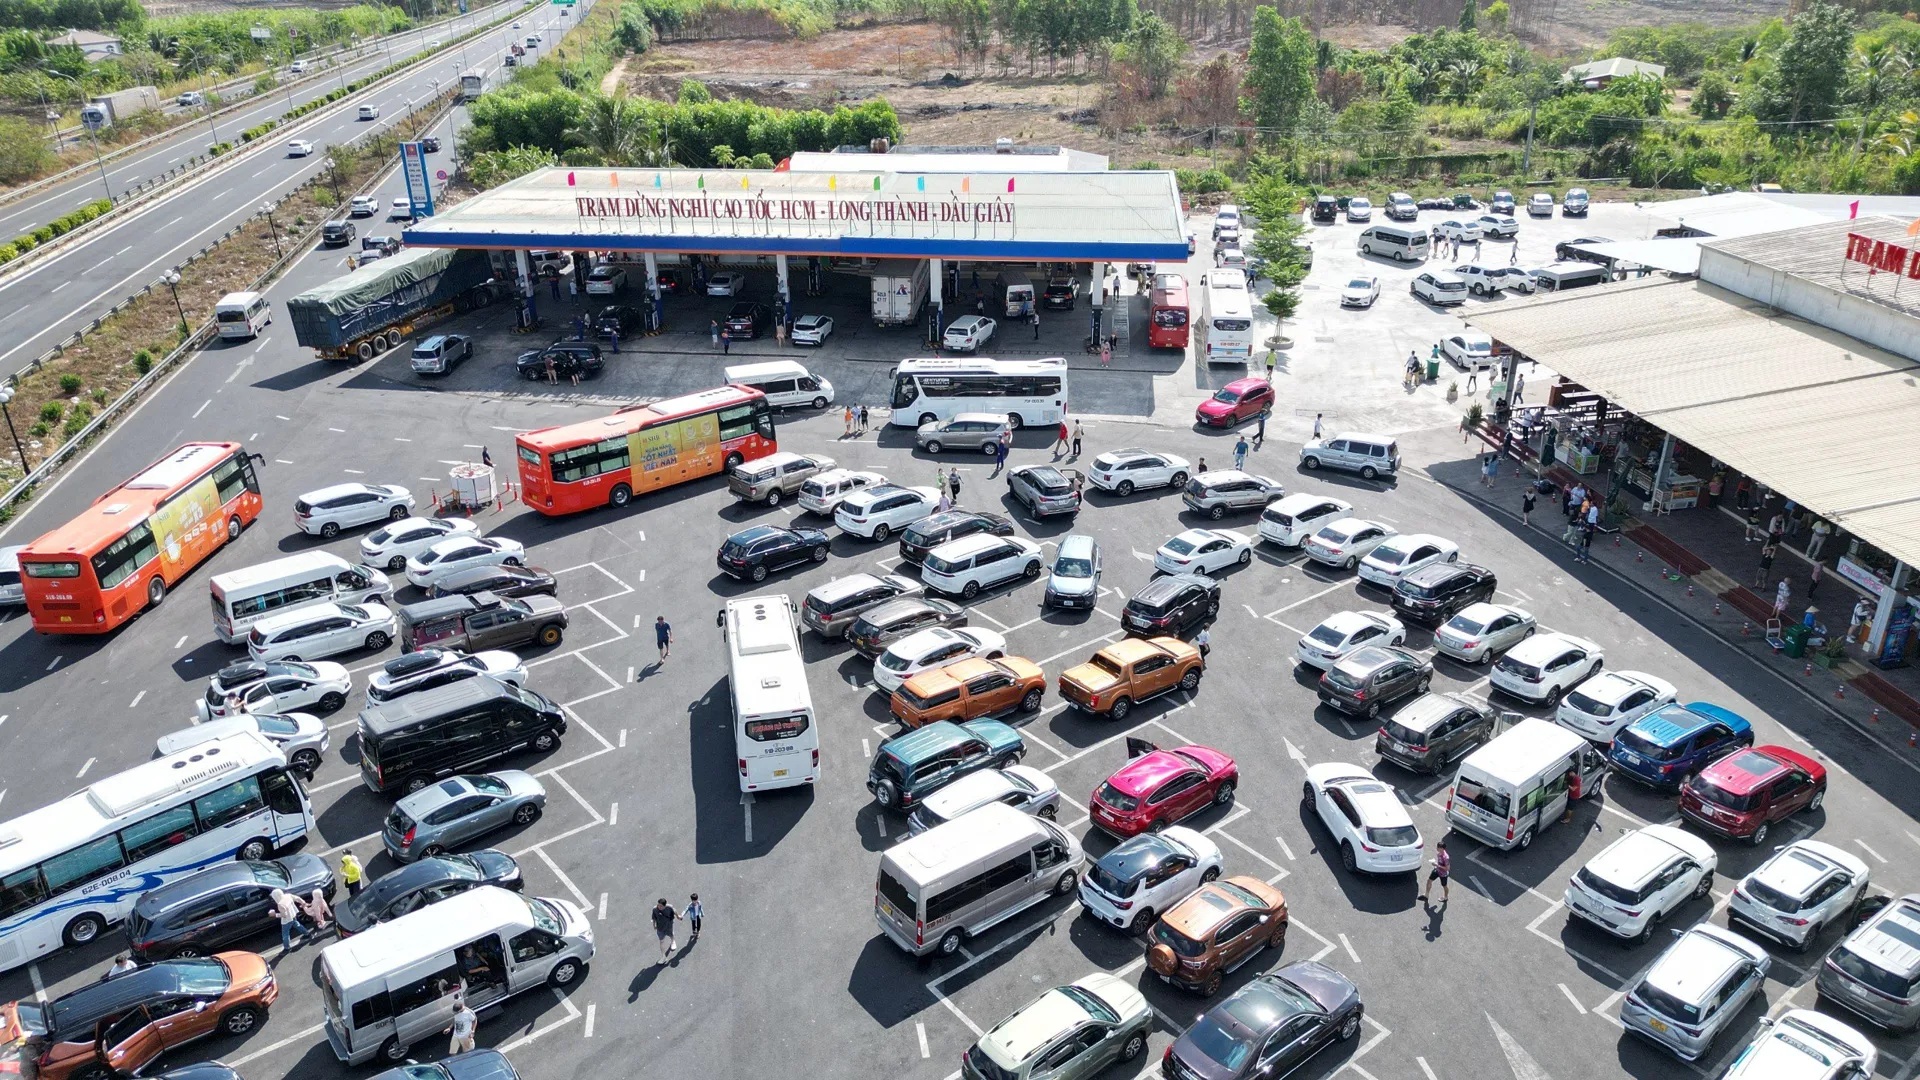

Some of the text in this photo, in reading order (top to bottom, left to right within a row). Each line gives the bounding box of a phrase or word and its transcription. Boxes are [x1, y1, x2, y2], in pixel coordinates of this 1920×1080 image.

[576, 197, 621, 221] TRẠM
[625, 190, 667, 218] DỪNG
[669, 189, 709, 219] NGHỈ
[712, 198, 742, 219] CAO
[745, 188, 776, 220] TỐC
[781, 199, 816, 220] HCM
[828, 199, 870, 221] LONG
[874, 194, 928, 222] THÀNH
[941, 190, 971, 222] DẦU
[974, 196, 1014, 223] GIÂY
[1846, 232, 1908, 275] TRẠM
[661, 457, 677, 467] NAM
